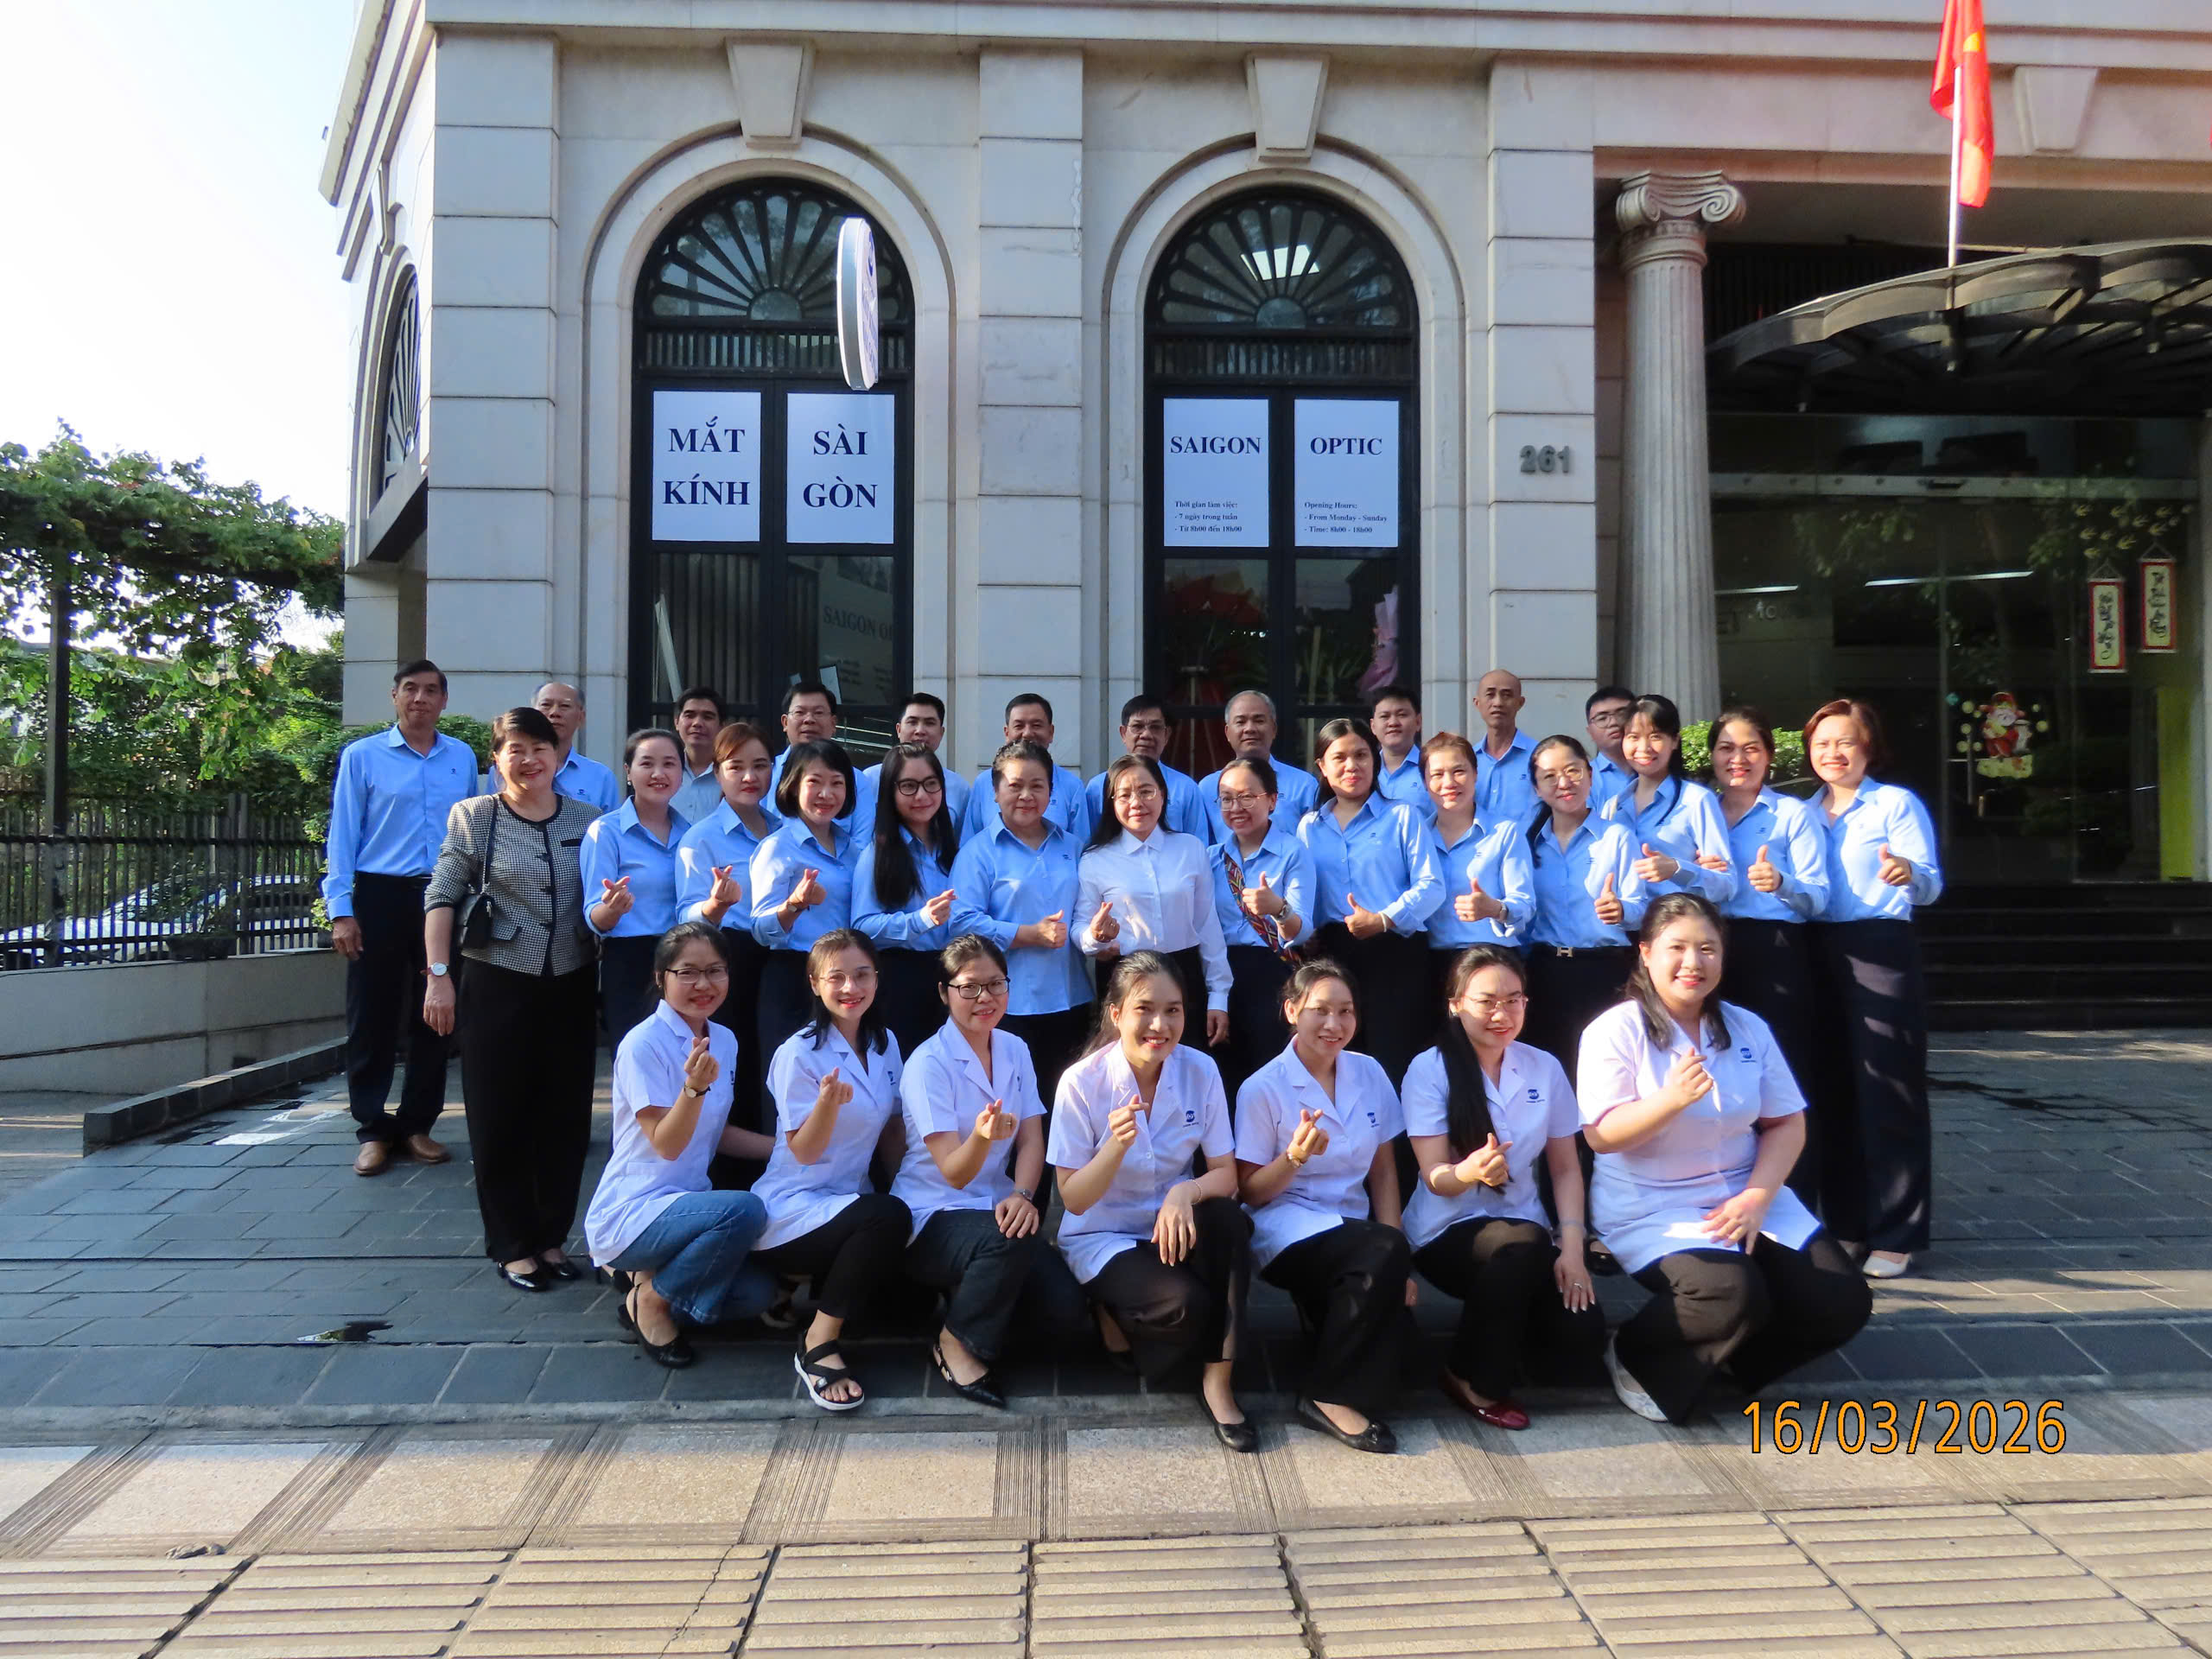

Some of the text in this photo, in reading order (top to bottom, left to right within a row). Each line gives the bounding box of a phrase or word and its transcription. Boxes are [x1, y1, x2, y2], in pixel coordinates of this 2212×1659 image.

[667, 416, 746, 453] MẮT
[812, 423, 868, 455] SÀI
[1170, 435, 1262, 454] SAIGON
[1310, 437, 1382, 455] OPTIC
[1519, 444, 1571, 474] 261
[662, 473, 751, 505] KÍNH
[803, 475, 878, 508] GÒN
[1192, 500, 1206, 509] gian
[1304, 501, 1333, 510] Opening
[1362, 514, 1388, 523] Sunday
[823, 606, 876, 639] SAIGON
